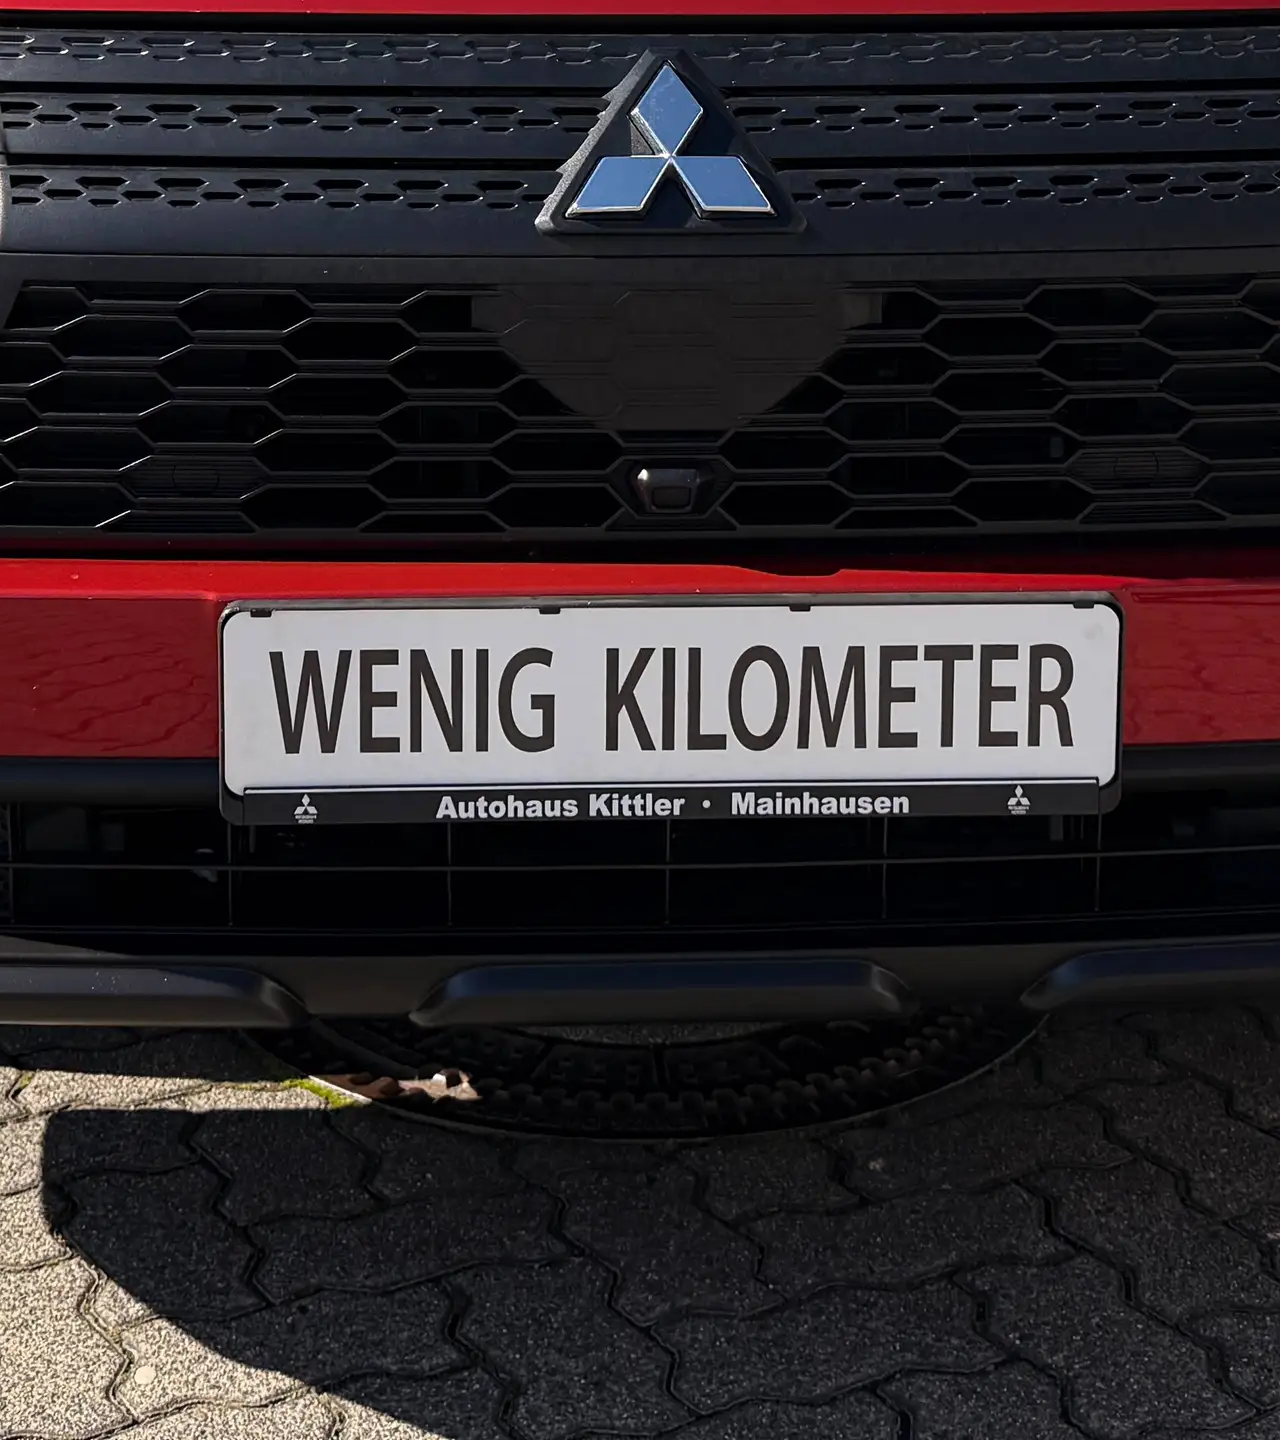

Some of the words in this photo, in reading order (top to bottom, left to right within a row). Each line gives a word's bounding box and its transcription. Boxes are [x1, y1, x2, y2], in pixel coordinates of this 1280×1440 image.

[269, 647, 555, 755] WENIG
[604, 643, 1075, 752] KILOMETER
[435, 792, 579, 819] Autohaus
[588, 791, 685, 818] Kittler
[730, 789, 910, 816] Mainhausen
